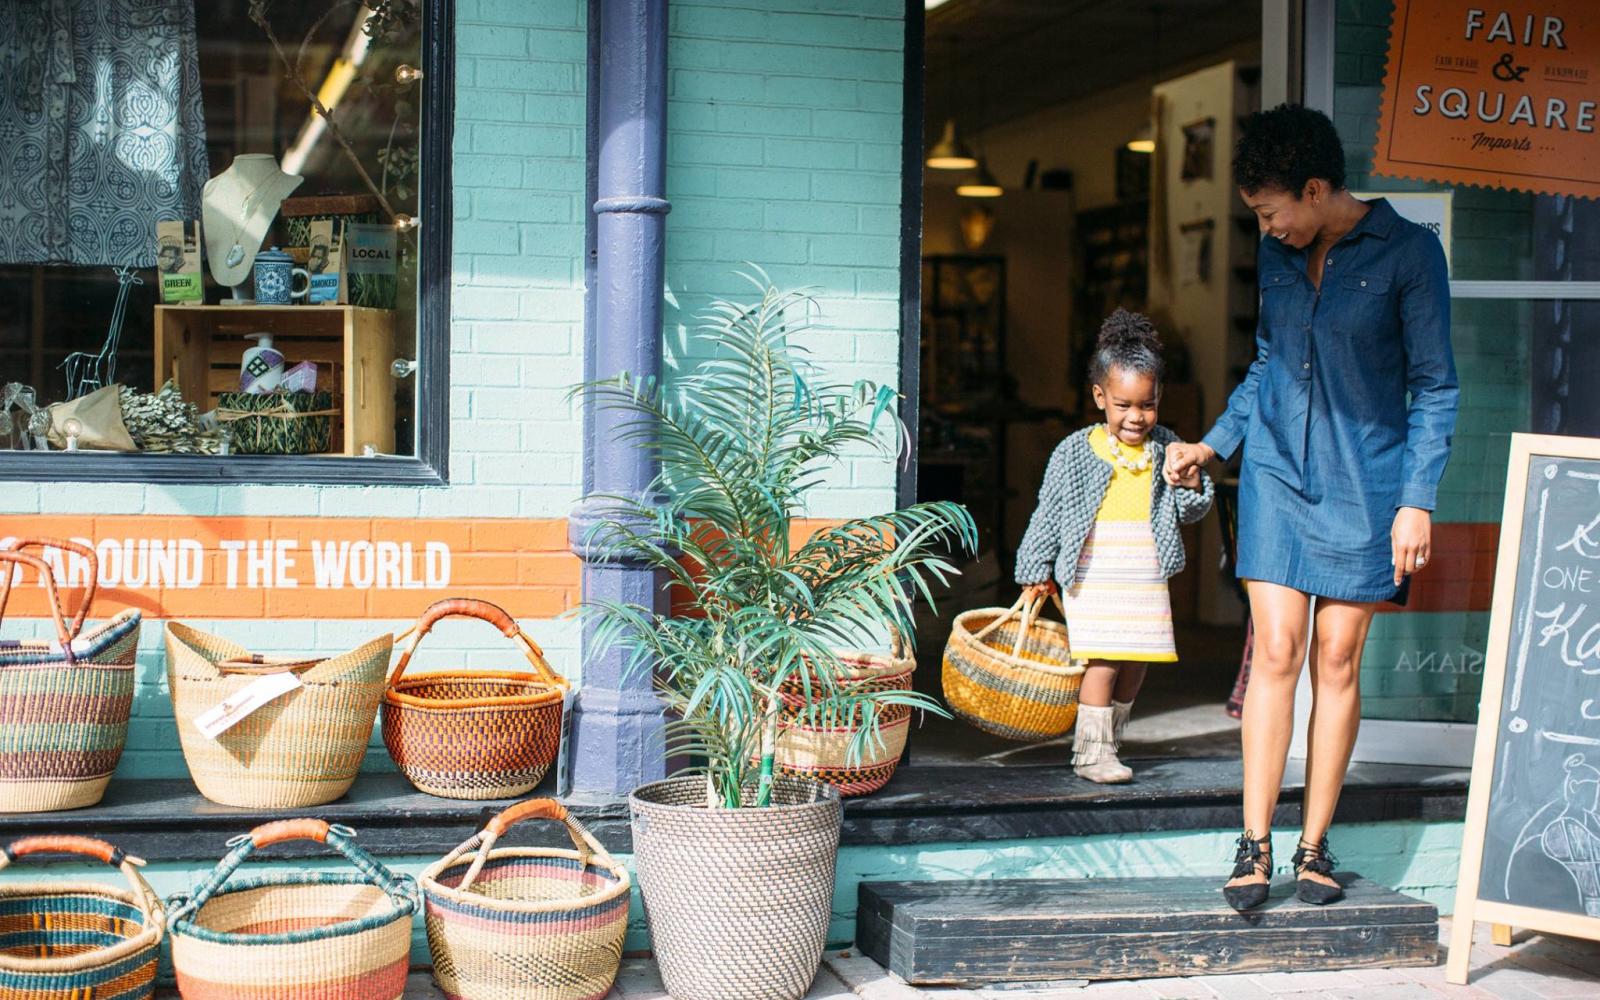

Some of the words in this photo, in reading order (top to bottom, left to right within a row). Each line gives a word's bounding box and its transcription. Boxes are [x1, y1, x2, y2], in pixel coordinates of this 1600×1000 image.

[1465, 9, 1566, 49] FAIR
[1492, 53, 1530, 83] &
[1413, 85, 1596, 133] SQUARE
[1471, 132, 1532, 151] Imports
[352, 248, 391, 260] LOCAL
[164, 279, 192, 288] GREEN
[311, 279, 338, 288] SMOKED
[38, 537, 204, 589] AROUND
[219, 540, 299, 589] THE
[311, 541, 451, 590] WORLD
[1543, 564, 1592, 593] ONE
